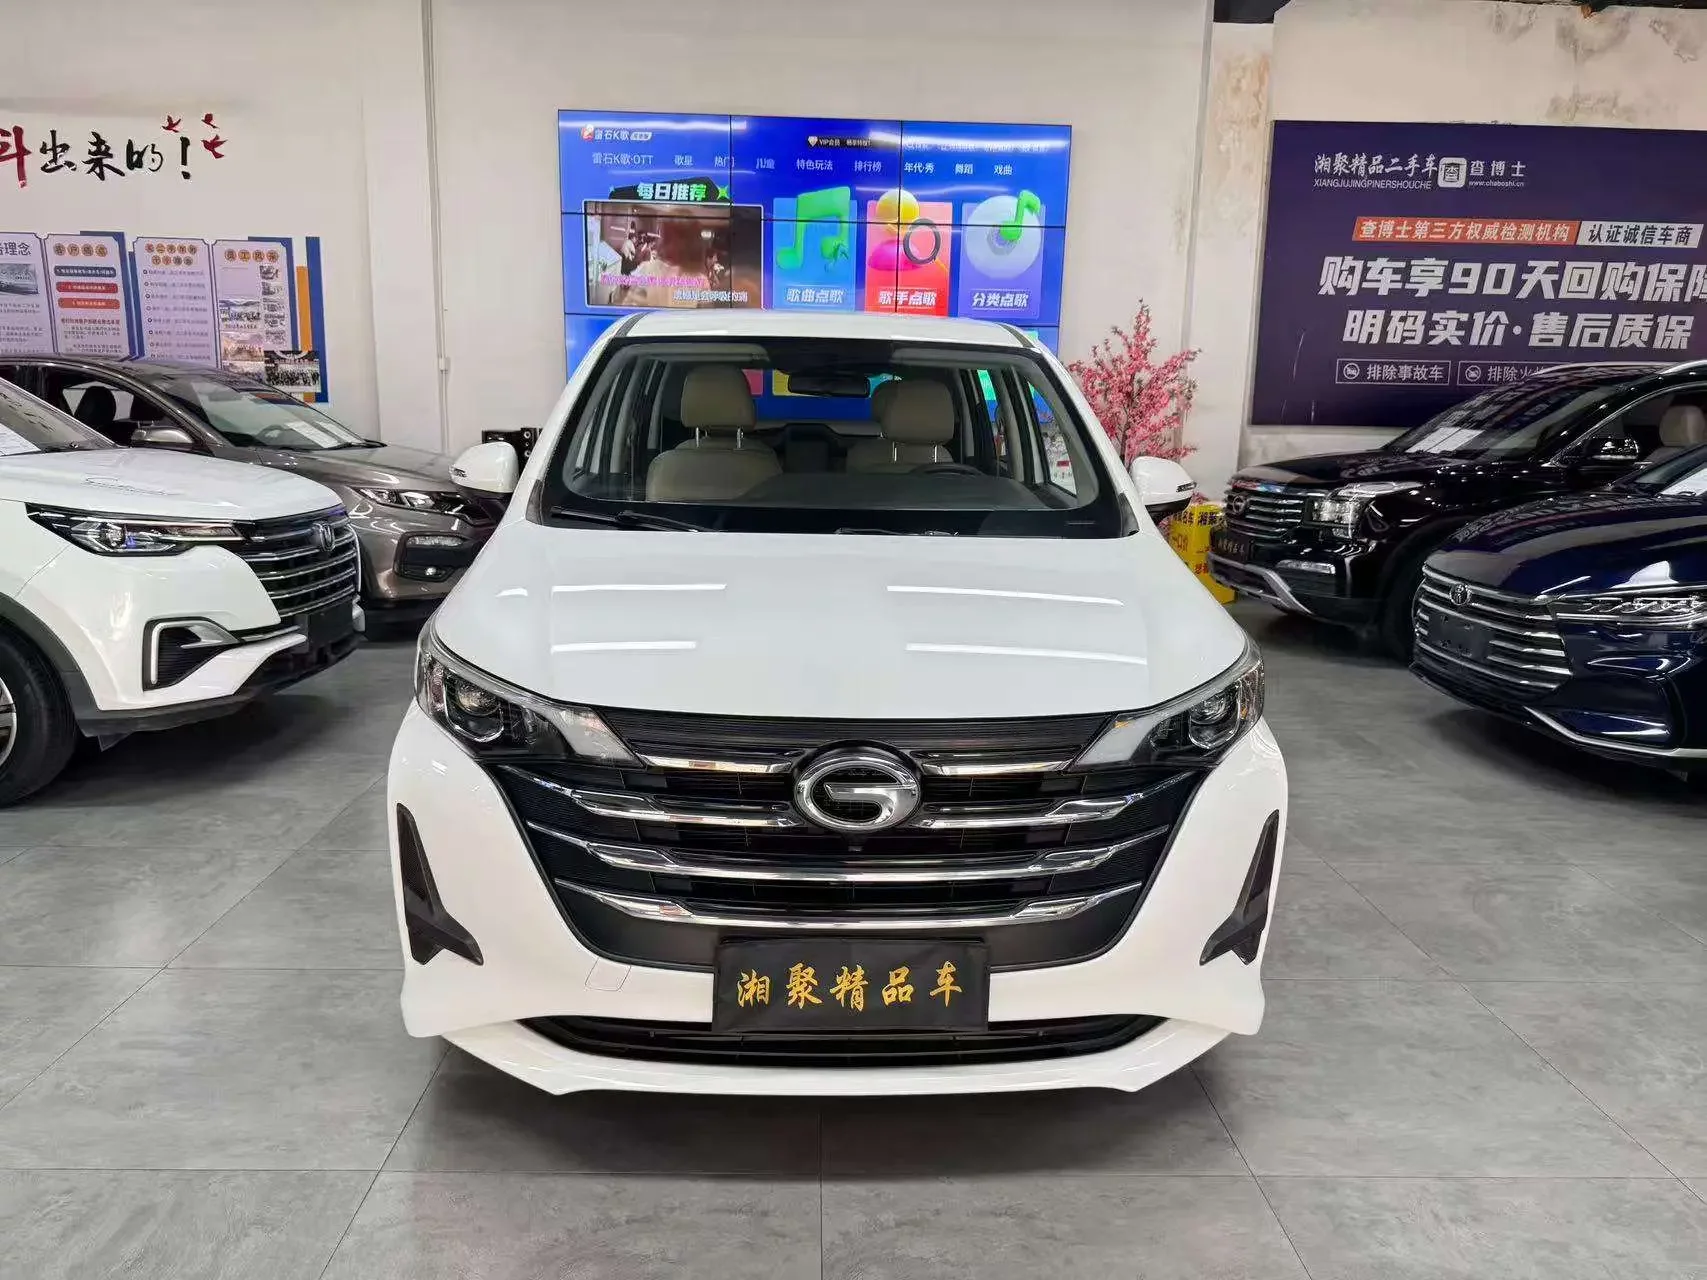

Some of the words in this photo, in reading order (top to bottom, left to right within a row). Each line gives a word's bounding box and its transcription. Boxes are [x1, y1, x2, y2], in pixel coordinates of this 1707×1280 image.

[595, 128, 630, 141] 雷石K歌
[674, 154, 694, 167] 歌星
[714, 155, 736, 168] 热门
[756, 157, 776, 170] 儿童
[796, 158, 834, 171] 特色玩法
[854, 160, 882, 173] 排行榜
[955, 163, 974, 175] 舞蹈
[993, 164, 1014, 176] 戏曲
[1314, 152, 1439, 177] 湘聚精品二手车
[1469, 160, 1527, 178] 查博士
[637, 182, 707, 201] 每日推荐
[1313, 179, 1433, 190] XIANGJUJINGPINERSHOUCHE
[1468, 179, 1525, 188] www.chaboshi.cn
[1359, 218, 1570, 243] 查博士第三方权威检测机构
[1587, 223, 1694, 247] 认证诚信车商
[0, 242, 32, 257] 理念
[786, 287, 845, 304] 歌曲点歌
[878, 290, 938, 307] 歌手点歌
[972, 292, 1030, 308] 分类点歌
[1342, 309, 1696, 350] 明码实价·售后质保
[1366, 364, 1445, 382] 排除事故车
[736, 960, 962, 1012] 湘聚精品车
